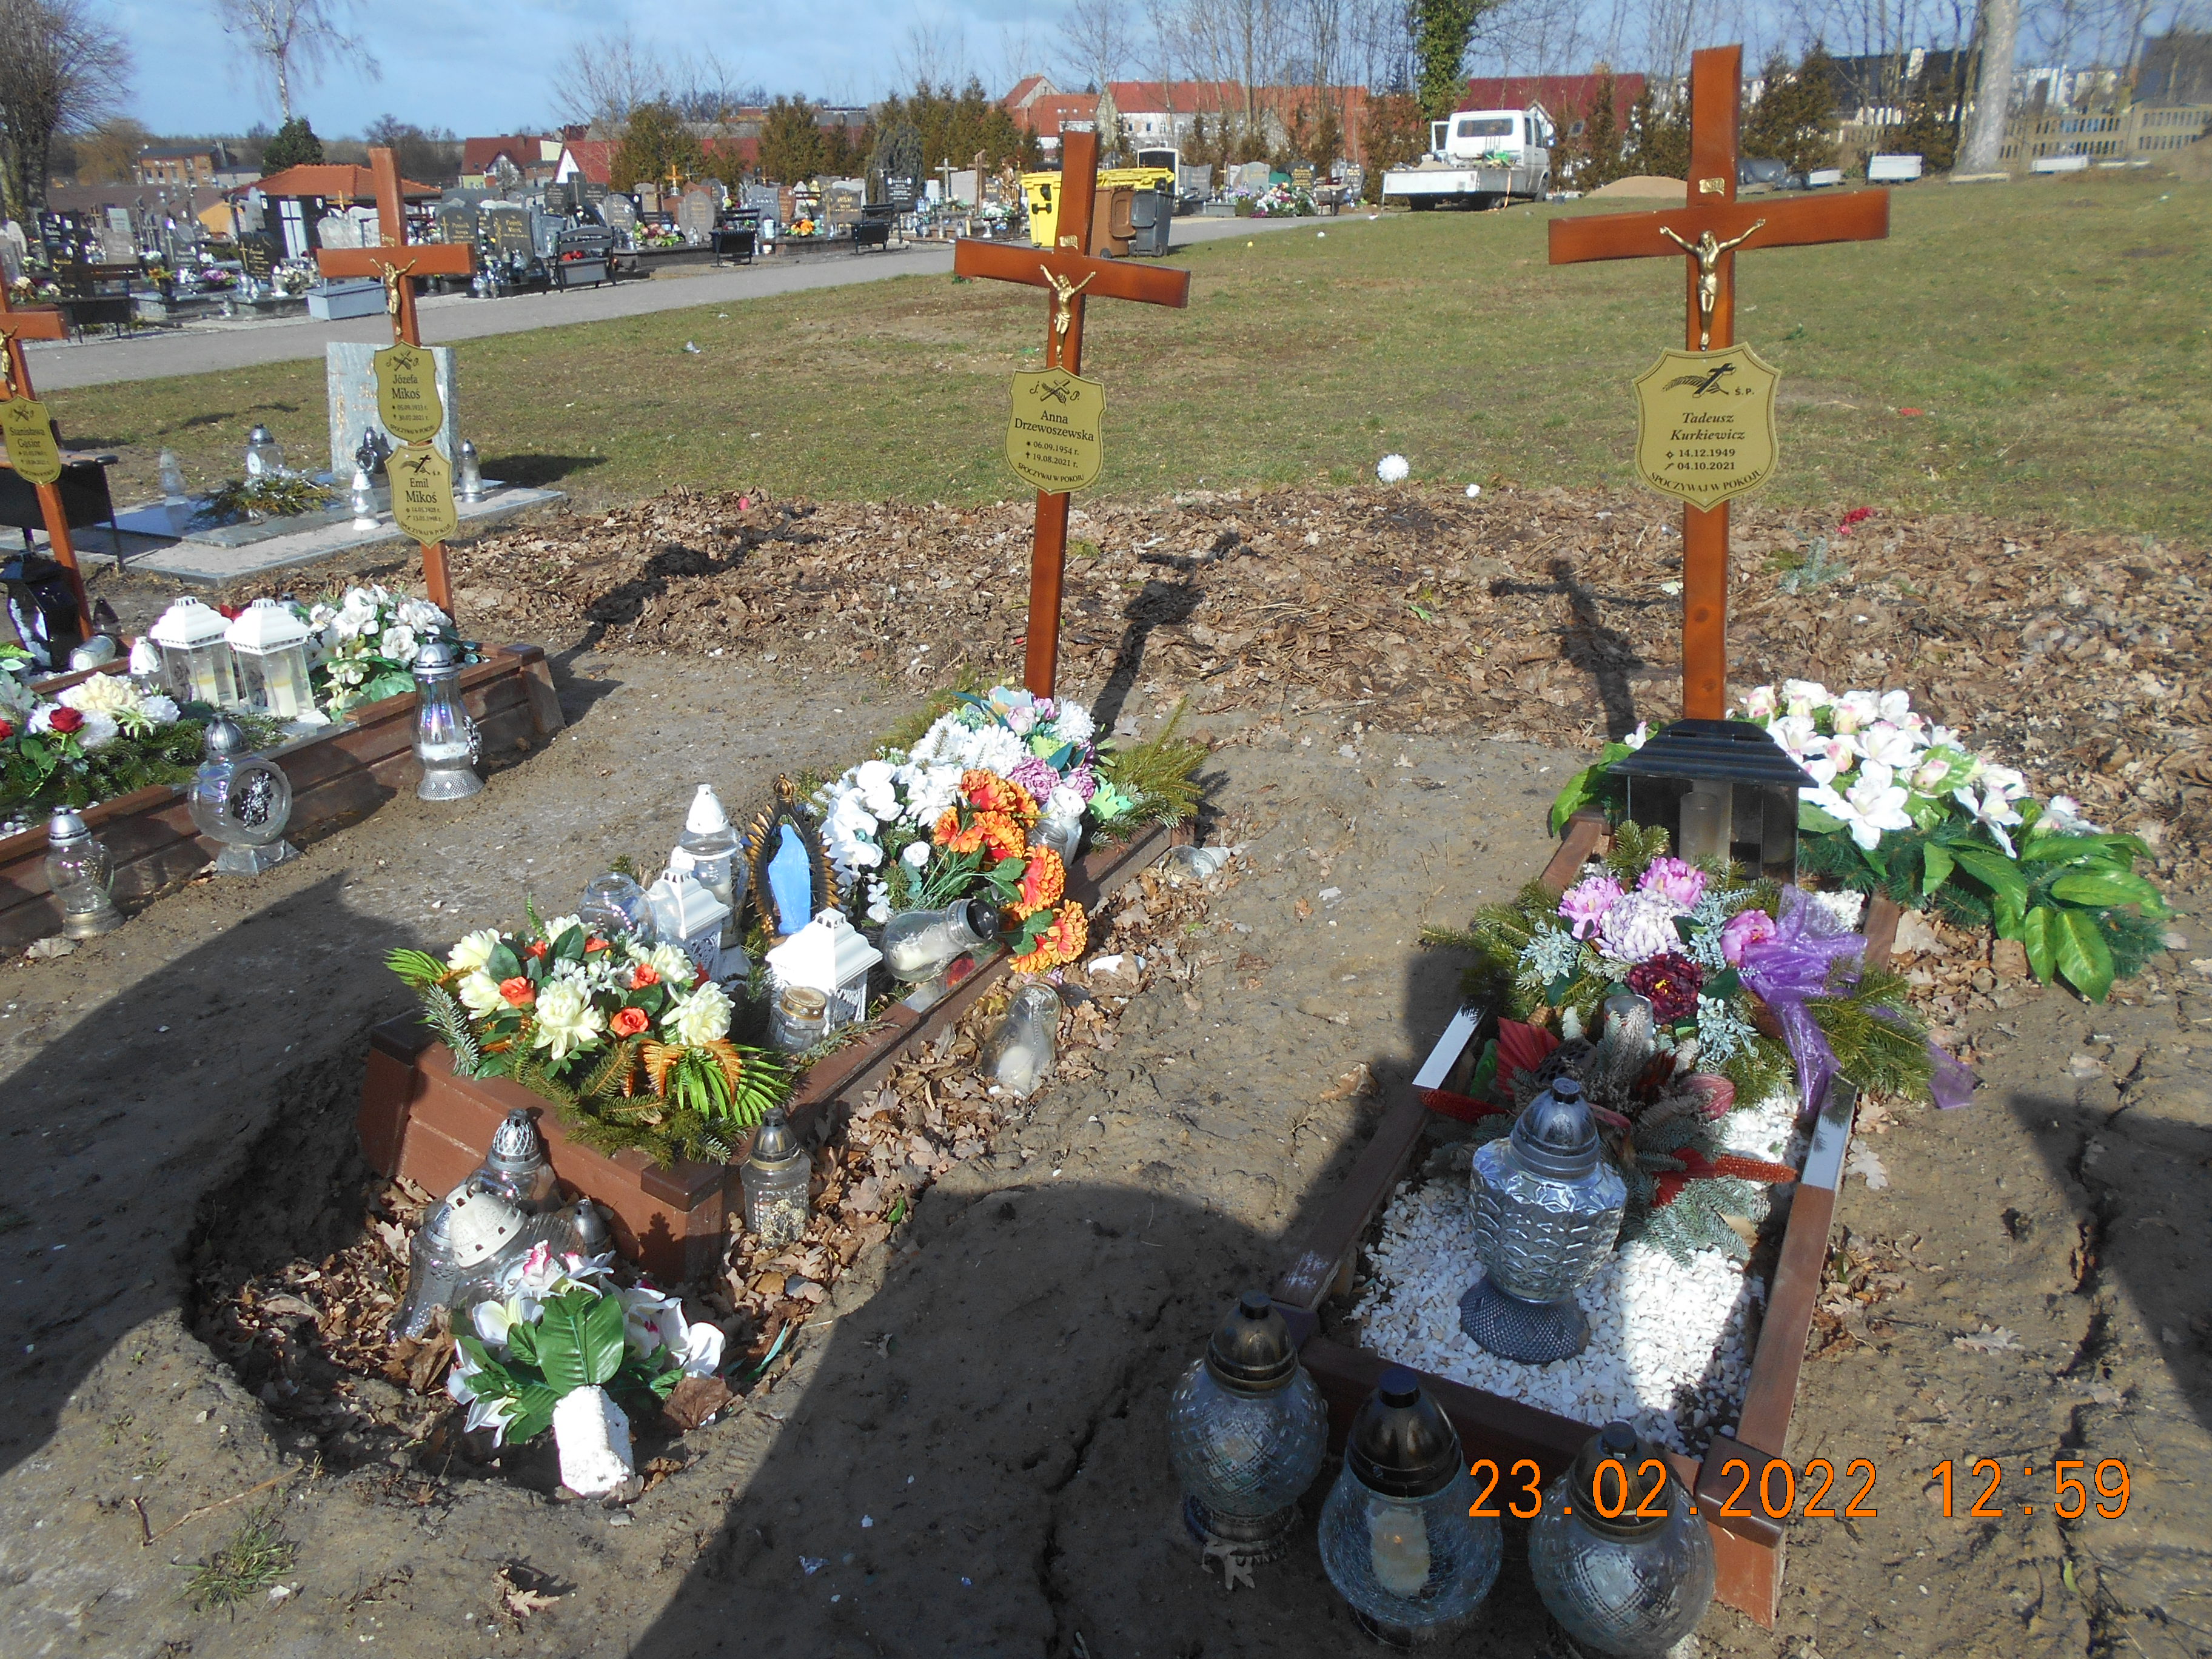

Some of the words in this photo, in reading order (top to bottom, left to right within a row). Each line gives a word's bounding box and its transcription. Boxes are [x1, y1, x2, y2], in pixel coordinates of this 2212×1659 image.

[393, 374, 418, 384] Józefa
[392, 388, 420, 399] Mikoś
[1041, 410, 1068, 424] Anna
[1682, 412, 1735, 423] Tadeusz
[1014, 418, 1094, 441] Drzewoszewska
[1671, 429, 1745, 440] Kurkiewicz
[1033, 441, 1072, 455] 06.09.1954
[1679, 449, 1735, 457] 14.12.1949
[1033, 453, 1070, 466] 19.08.2021
[1018, 463, 1051, 481] SPOCZYWAJ
[410, 478, 429, 488] Emil
[1650, 472, 1708, 492] SPOCZYWAJ
[1723, 469, 1763, 490] POKOJU
[406, 491, 437, 503] Mikoś
